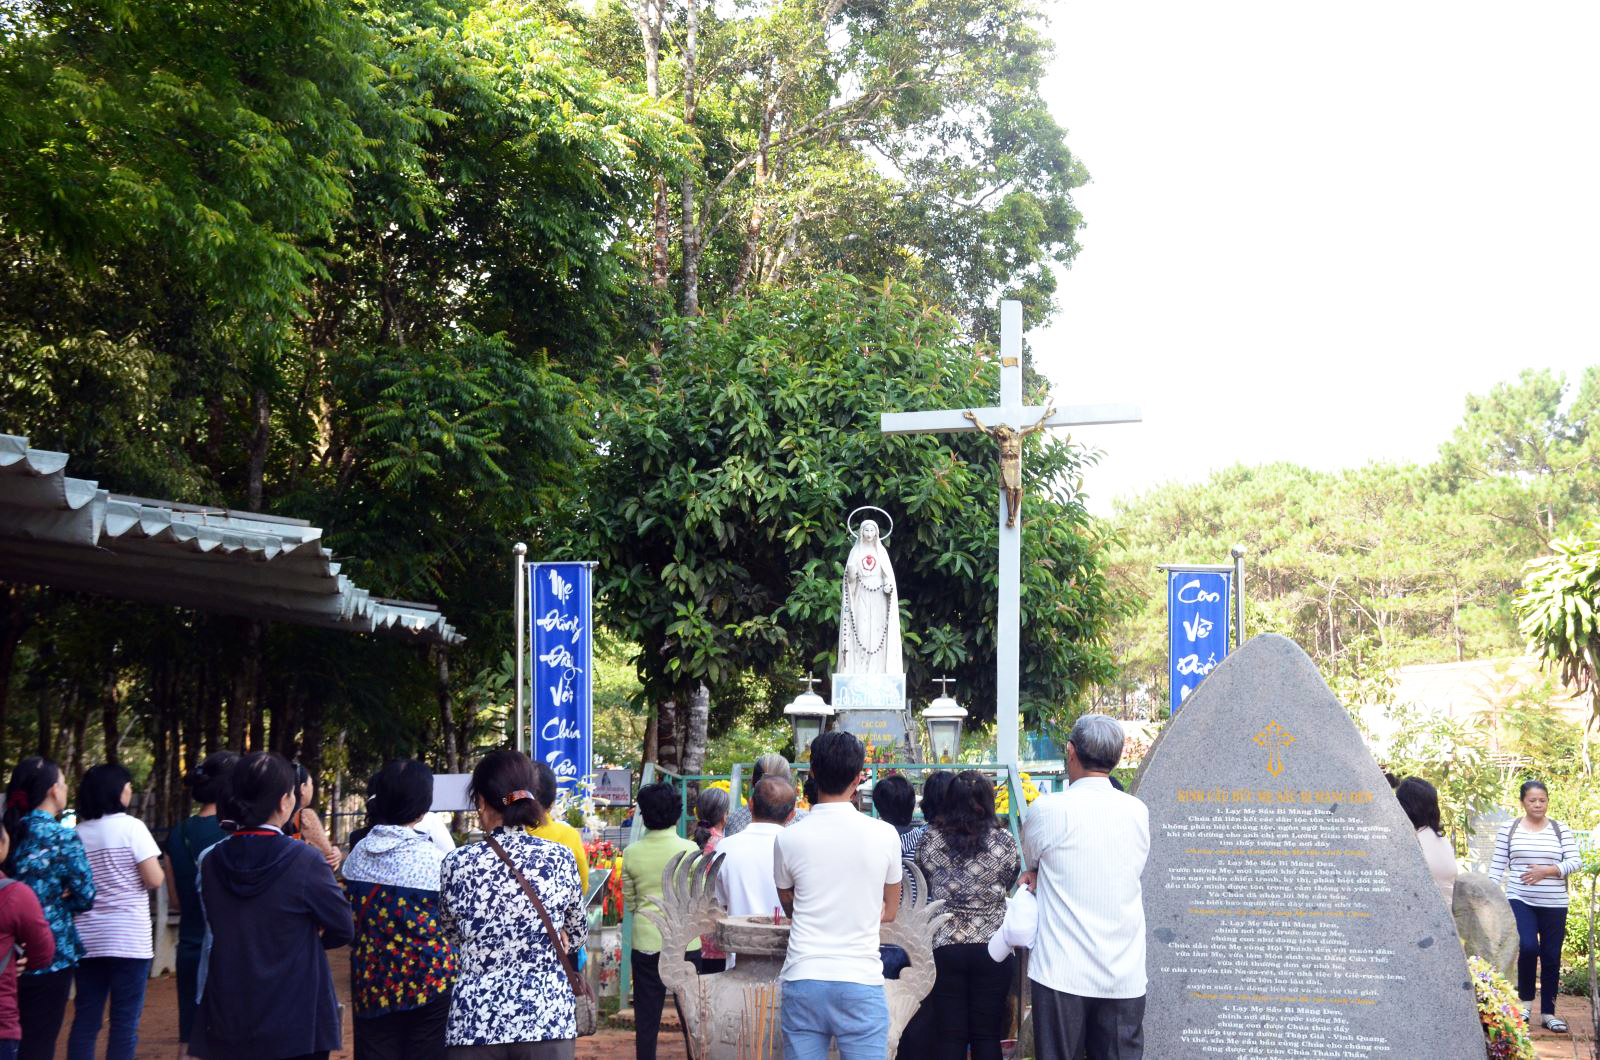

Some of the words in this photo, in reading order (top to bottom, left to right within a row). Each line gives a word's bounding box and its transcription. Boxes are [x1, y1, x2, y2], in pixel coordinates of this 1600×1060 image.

[549, 569, 573, 605] Mẹ
[1178, 579, 1220, 604] Con
[537, 608, 584, 644] Đứng
[1183, 611, 1214, 642] Về
[540, 645, 583, 681] Đây
[1177, 652, 1217, 676] Dướ
[542, 716, 581, 740] Chúa
